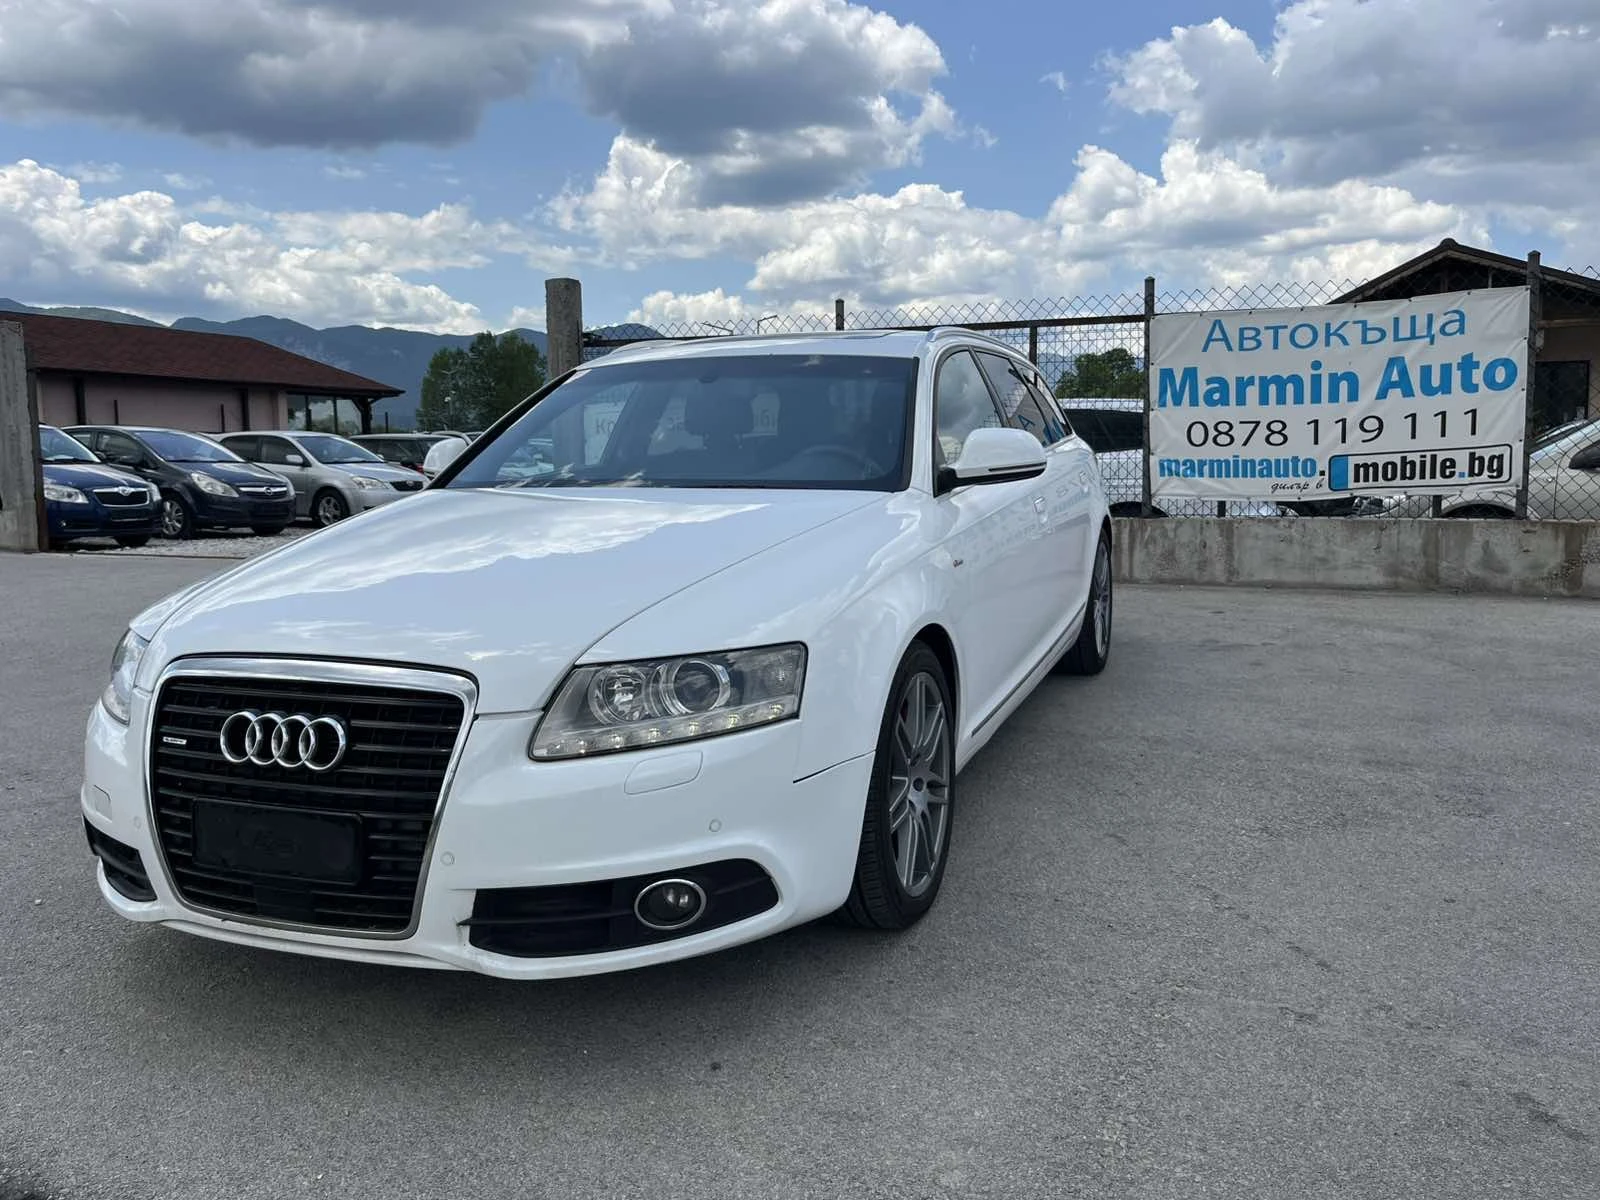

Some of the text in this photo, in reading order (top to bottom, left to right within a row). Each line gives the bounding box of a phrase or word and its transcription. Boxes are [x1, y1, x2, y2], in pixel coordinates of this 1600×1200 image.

[1201, 307, 1466, 353] Автокъща
[1157, 351, 1518, 408] Marmin Auto
[1186, 408, 1478, 447] 0878 119 111
[1353, 452, 1504, 483] mobile.bg
